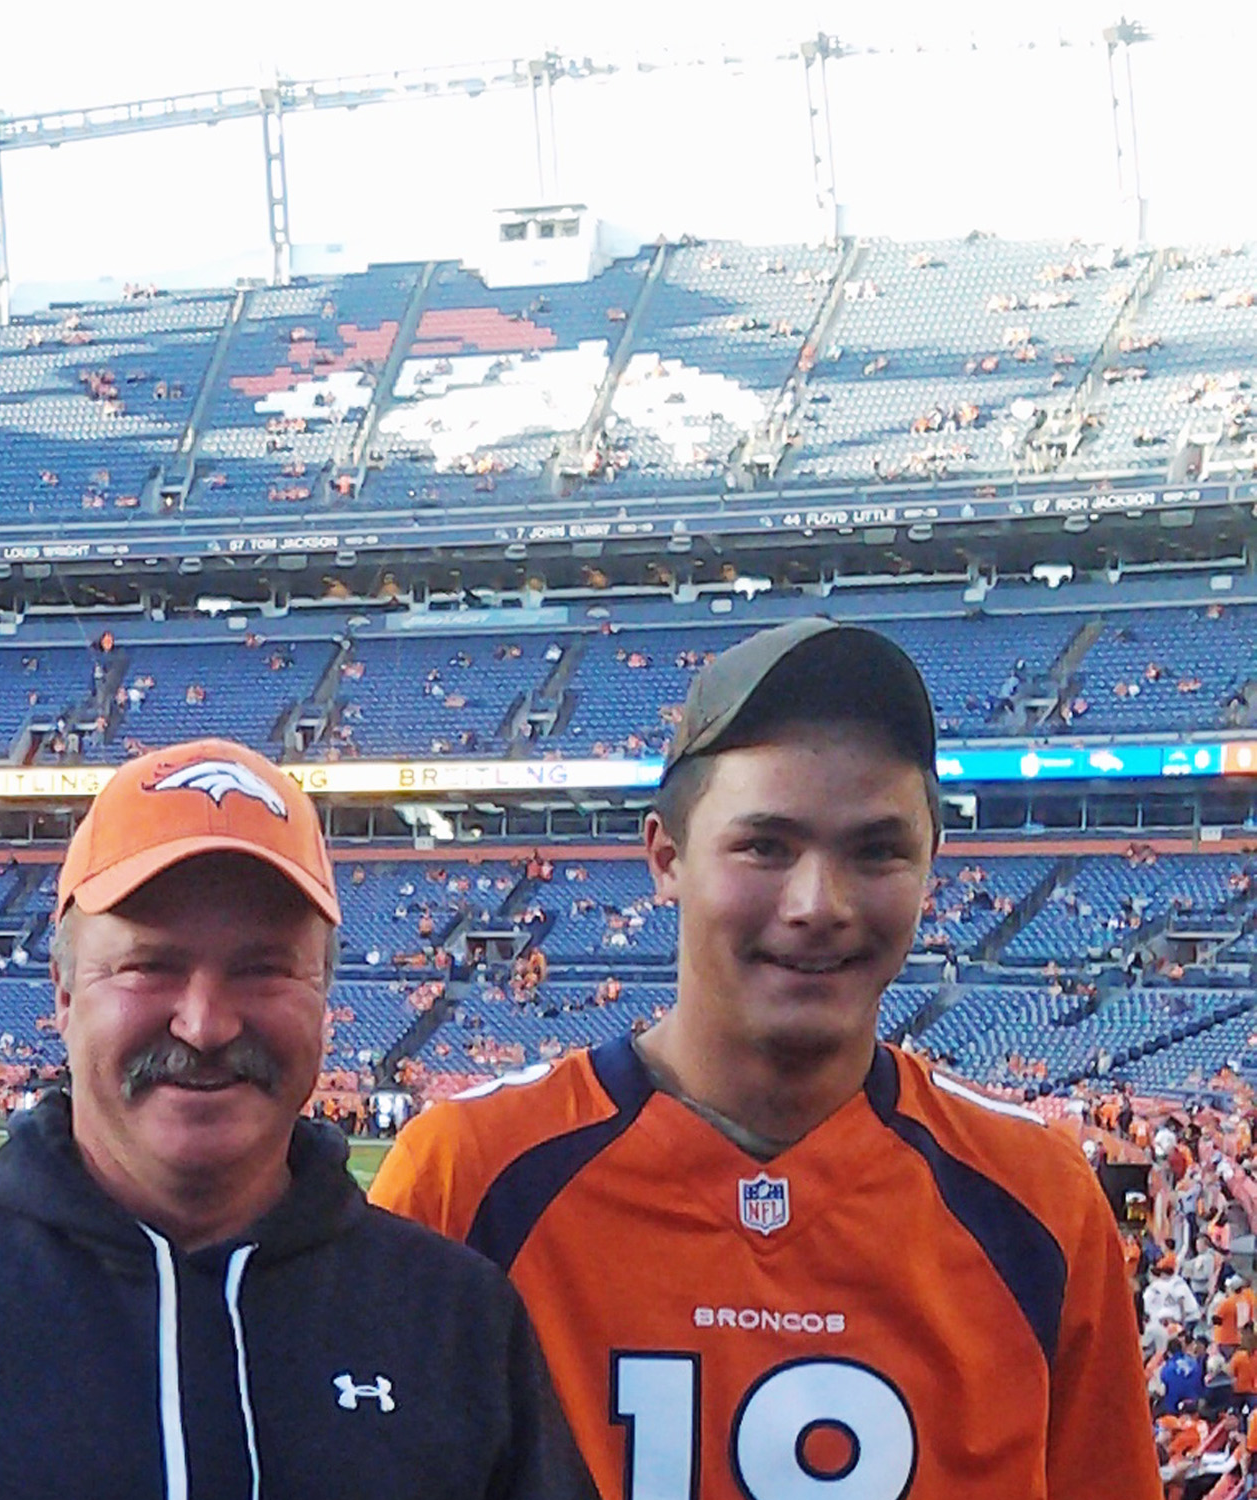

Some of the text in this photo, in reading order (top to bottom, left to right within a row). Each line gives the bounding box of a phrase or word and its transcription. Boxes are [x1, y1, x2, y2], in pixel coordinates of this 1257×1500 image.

[806, 512, 848, 526] FLOYD
[852, 508, 896, 523] LITTLE
[748, 1200, 783, 1225] NFL
[693, 1306, 846, 1334] BRONCOS
